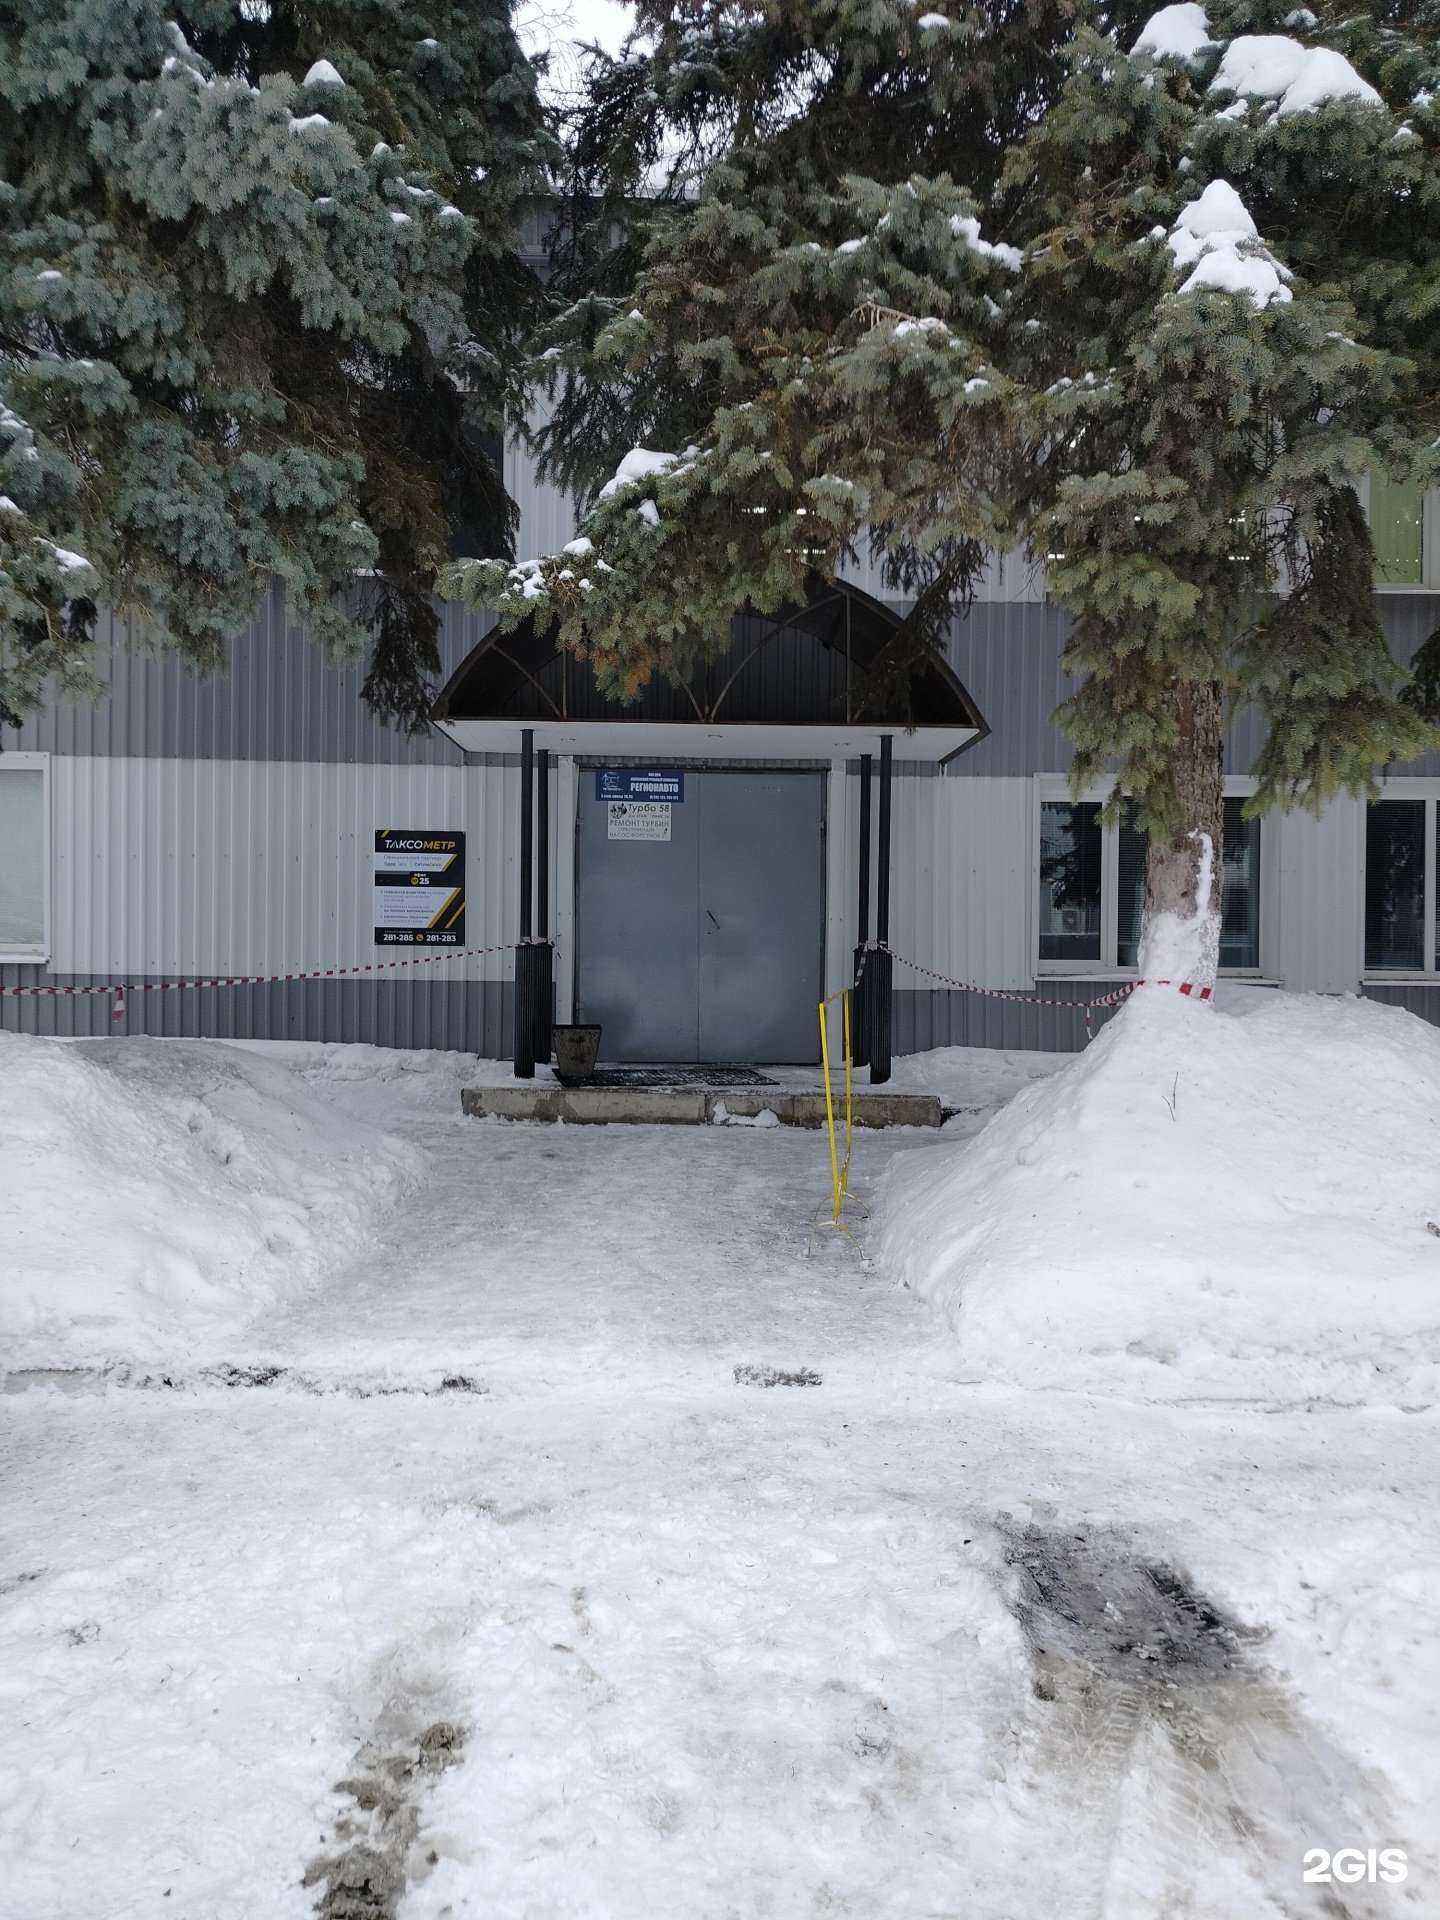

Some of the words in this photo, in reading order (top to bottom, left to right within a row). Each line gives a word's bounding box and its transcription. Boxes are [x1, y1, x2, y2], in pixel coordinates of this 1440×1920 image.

[630, 782, 679, 793] РЕГИОНАВТО
[628, 803, 657, 813] Турбо
[659, 804, 670, 813] 58
[384, 839, 456, 850] ТАКСОМЕТР
[419, 877, 430, 885] 25
[383, 934, 414, 942] 281-285
[426, 934, 457, 942] 281-283
